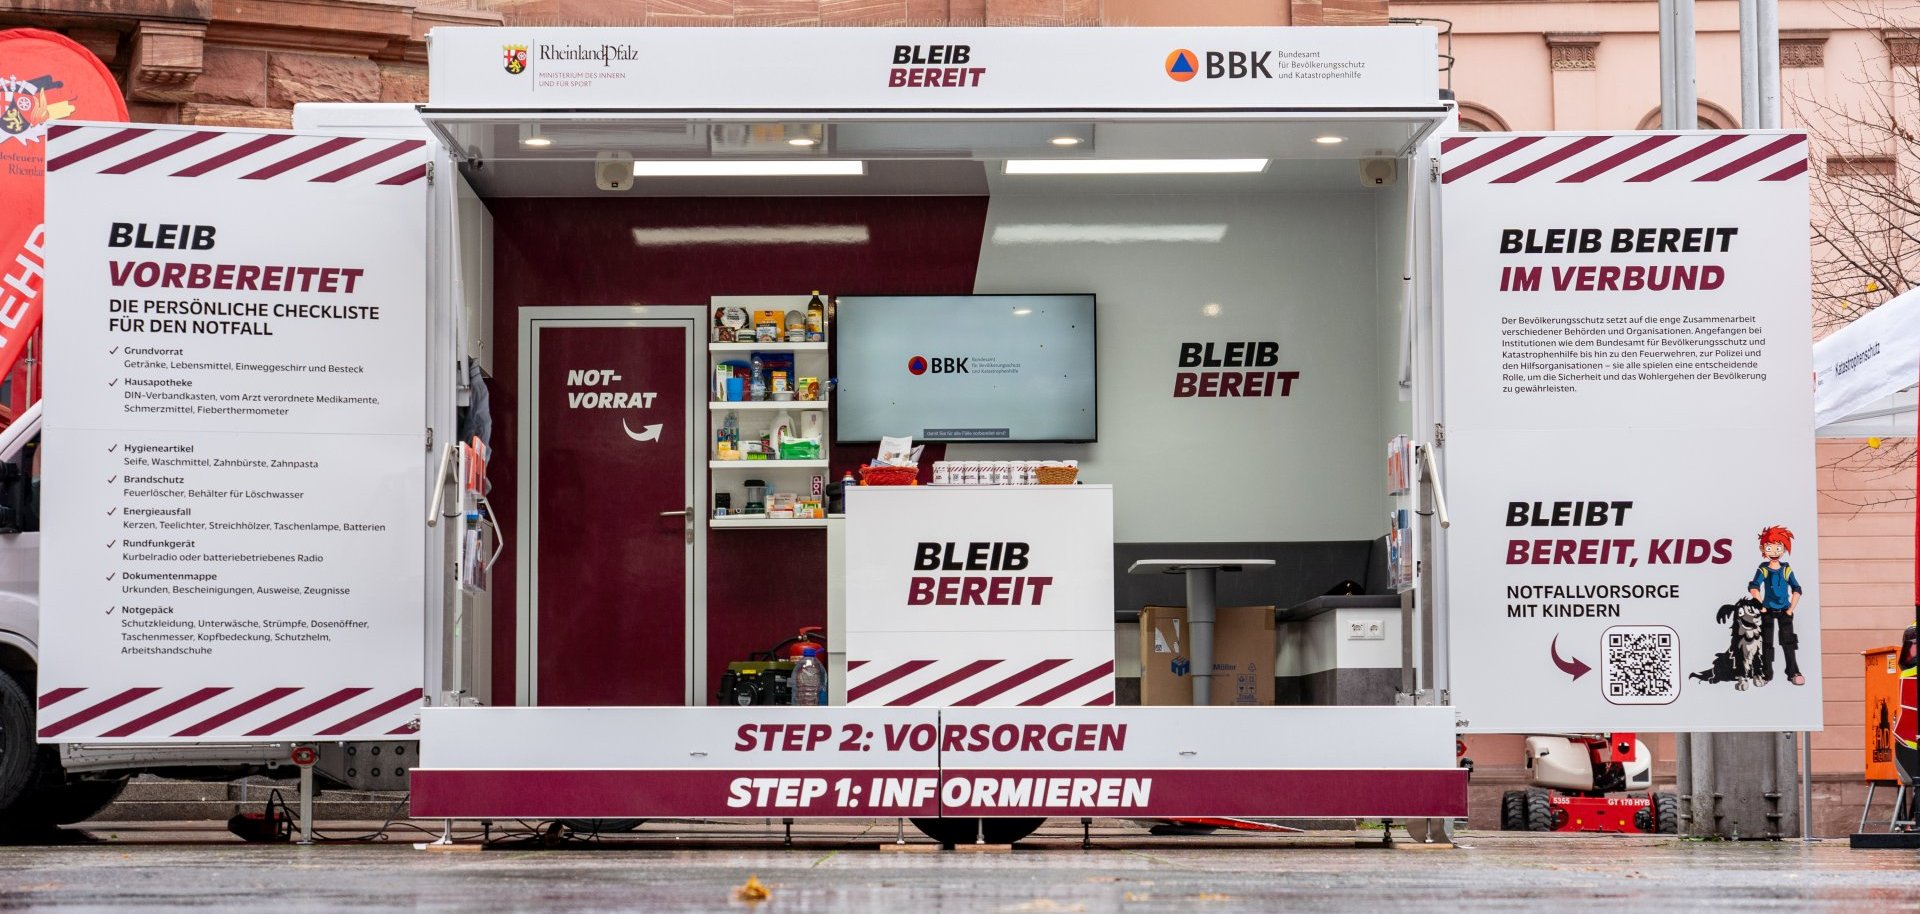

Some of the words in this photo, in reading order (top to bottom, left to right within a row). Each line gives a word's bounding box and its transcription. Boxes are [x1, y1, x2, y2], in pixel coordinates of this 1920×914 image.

[892, 45, 971, 64] BLEIB
[1278, 50, 1320, 58] Bundesamt
[1206, 51, 1273, 79] BBK
[1278, 60, 1289, 69] für
[1291, 60, 1365, 70] Bevölkerungsschutz
[888, 68, 986, 88] BEREIT
[1278, 71, 1293, 79] und
[1295, 70, 1362, 80] Katastrophenhilfe
[570, 80, 592, 88] SPORT
[108, 222, 216, 250] BLEIB
[1499, 228, 1602, 254] BLEIB
[1610, 227, 1739, 253] BEREIT
[109, 260, 364, 294] VORBEREITET
[1499, 266, 1543, 292] IM
[1551, 265, 1725, 291] VERBUND
[110, 299, 138, 313] DIE
[144, 298, 268, 317] PERSÖNLICHE
[273, 304, 379, 320] CHECKLISTE
[109, 316, 144, 332] FÜR
[150, 319, 187, 333] DEN
[193, 320, 273, 336] NOTFALL
[1501, 317, 1517, 325] Der
[1518, 316, 1604, 326] Bevölkerungsschutz
[1629, 315, 1643, 324] auf
[1644, 316, 1658, 324] die
[1659, 317, 1681, 325] enge
[1683, 315, 1756, 324] Zusammenarbeit
[1501, 328, 1563, 336] verschiedener
[1564, 327, 1606, 336] Behörden
[1626, 327, 1694, 337] Organisationen.
[1694, 326, 1747, 336] Angefangen
[1748, 326, 1762, 334] bei
[1502, 339, 1557, 347] Institutionen
[1558, 339, 1573, 347] wie
[1574, 339, 1594, 347] dem
[1596, 339, 1645, 347] Bundesamt
[1646, 338, 1660, 347] für
[1661, 338, 1747, 348] Bevölkerungsschutz
[1749, 338, 1766, 346] und
[124, 346, 183, 356] Grundvorrat
[1178, 341, 1279, 368] BLEIB
[1502, 350, 1578, 359] Katastrophenhilfe
[1580, 350, 1593, 358] bis
[1594, 350, 1608, 358] hin
[1621, 350, 1638, 358] den
[1639, 350, 1698, 358] Feuerwehren,
[1715, 349, 1743, 357] Polizei
[1744, 349, 1762, 357] und
[124, 359, 168, 369] Getränke,
[170, 361, 234, 371] Lebensmittel,
[235, 362, 307, 373] Einweggeschirr
[308, 364, 326, 373] und
[328, 364, 364, 373] Besteck
[931, 357, 969, 374] BBK
[1502, 362, 1519, 370] den
[1520, 361, 1603, 372] Hilfsorganisationen
[1612, 361, 1625, 370] sie
[1626, 361, 1641, 369] alle
[1642, 361, 1673, 370] spielen
[1674, 361, 1693, 369] eine
[1694, 360, 1758, 369] entscheidende
[124, 378, 193, 388] Hausapotheke
[567, 369, 622, 386] NOT-
[1502, 373, 1526, 382] Rolle,
[1543, 373, 1557, 381] die
[1558, 373, 1602, 381] Sicherheit
[1603, 373, 1620, 381] und
[1621, 373, 1637, 381] das
[1638, 372, 1695, 382] Wohlergehen
[1696, 372, 1712, 380] der
[1713, 372, 1767, 382] Bevölkerung
[1173, 371, 1300, 398] BEREIT
[1514, 384, 1577, 394] gewährleisten.
[124, 391, 218, 401] DIN-Verbandkasten,
[241, 393, 262, 402] Arzt
[263, 394, 314, 403] verordnete
[316, 395, 379, 405] Medikamente,
[568, 392, 658, 409] VORRAT
[124, 404, 195, 414] Schmerzmittel,
[197, 405, 289, 416] Fieberthermometer
[124, 444, 194, 454] Hygieneartikel
[124, 457, 150, 466] Seife,
[151, 458, 211, 467] Waschmittel,
[213, 458, 269, 468] Zahnbürste,
[270, 459, 319, 469] Zahnpasta
[124, 475, 184, 484] Brandschutz
[123, 488, 186, 498] Feuerlöscher,
[188, 489, 228, 498] Behälter
[229, 489, 244, 498] für
[245, 490, 304, 499] Löschwasser
[123, 507, 191, 517] Energieausfall
[1505, 501, 1633, 527] BLEIBT
[123, 520, 158, 530] Kerzen,
[159, 521, 207, 530] Teelichter,
[209, 521, 272, 531] Streichhölzer,
[273, 522, 341, 532] Taschenlampe,
[343, 523, 386, 531] Batterien
[123, 539, 195, 550] Rundfunkgerät
[122, 553, 178, 561] Kurbelradio
[179, 553, 202, 561] oder
[203, 553, 296, 562] batteriebetriebenes
[297, 554, 324, 562] Radio
[913, 542, 1030, 571] BLEIB
[1505, 539, 1638, 568] BEREIT,
[1647, 538, 1733, 565] KIDS
[122, 572, 217, 582] Dokumentenmappe
[122, 585, 170, 594] Urkunden,
[172, 585, 255, 596] Bescheinigungen,
[256, 586, 302, 595] Ausweise,
[303, 586, 350, 596] Zeugnisse
[907, 576, 1053, 606] BEREIT
[1507, 585, 1679, 599] NOTFALLVORSORGE
[122, 606, 174, 616] Notgepäck
[1507, 604, 1538, 618] MIT
[1543, 604, 1620, 617] KINDERN
[121, 619, 196, 630] Schutzkleidung,
[198, 619, 261, 629] Unterwäsche,
[263, 619, 309, 629] Strümpfe,
[311, 619, 369, 629] Dosenöffner,
[121, 632, 196, 642] Taschenmesser,
[197, 632, 273, 643] Kopfbedeckung,
[274, 633, 331, 642] Schutzhelm,
[121, 646, 212, 655] Arbeitshandschuhe
[734, 723, 832, 752] STEP
[838, 723, 874, 752] 2:
[885, 723, 1127, 752] VORSORGEN
[727, 777, 829, 807] STEP
[834, 777, 862, 807] 1:
